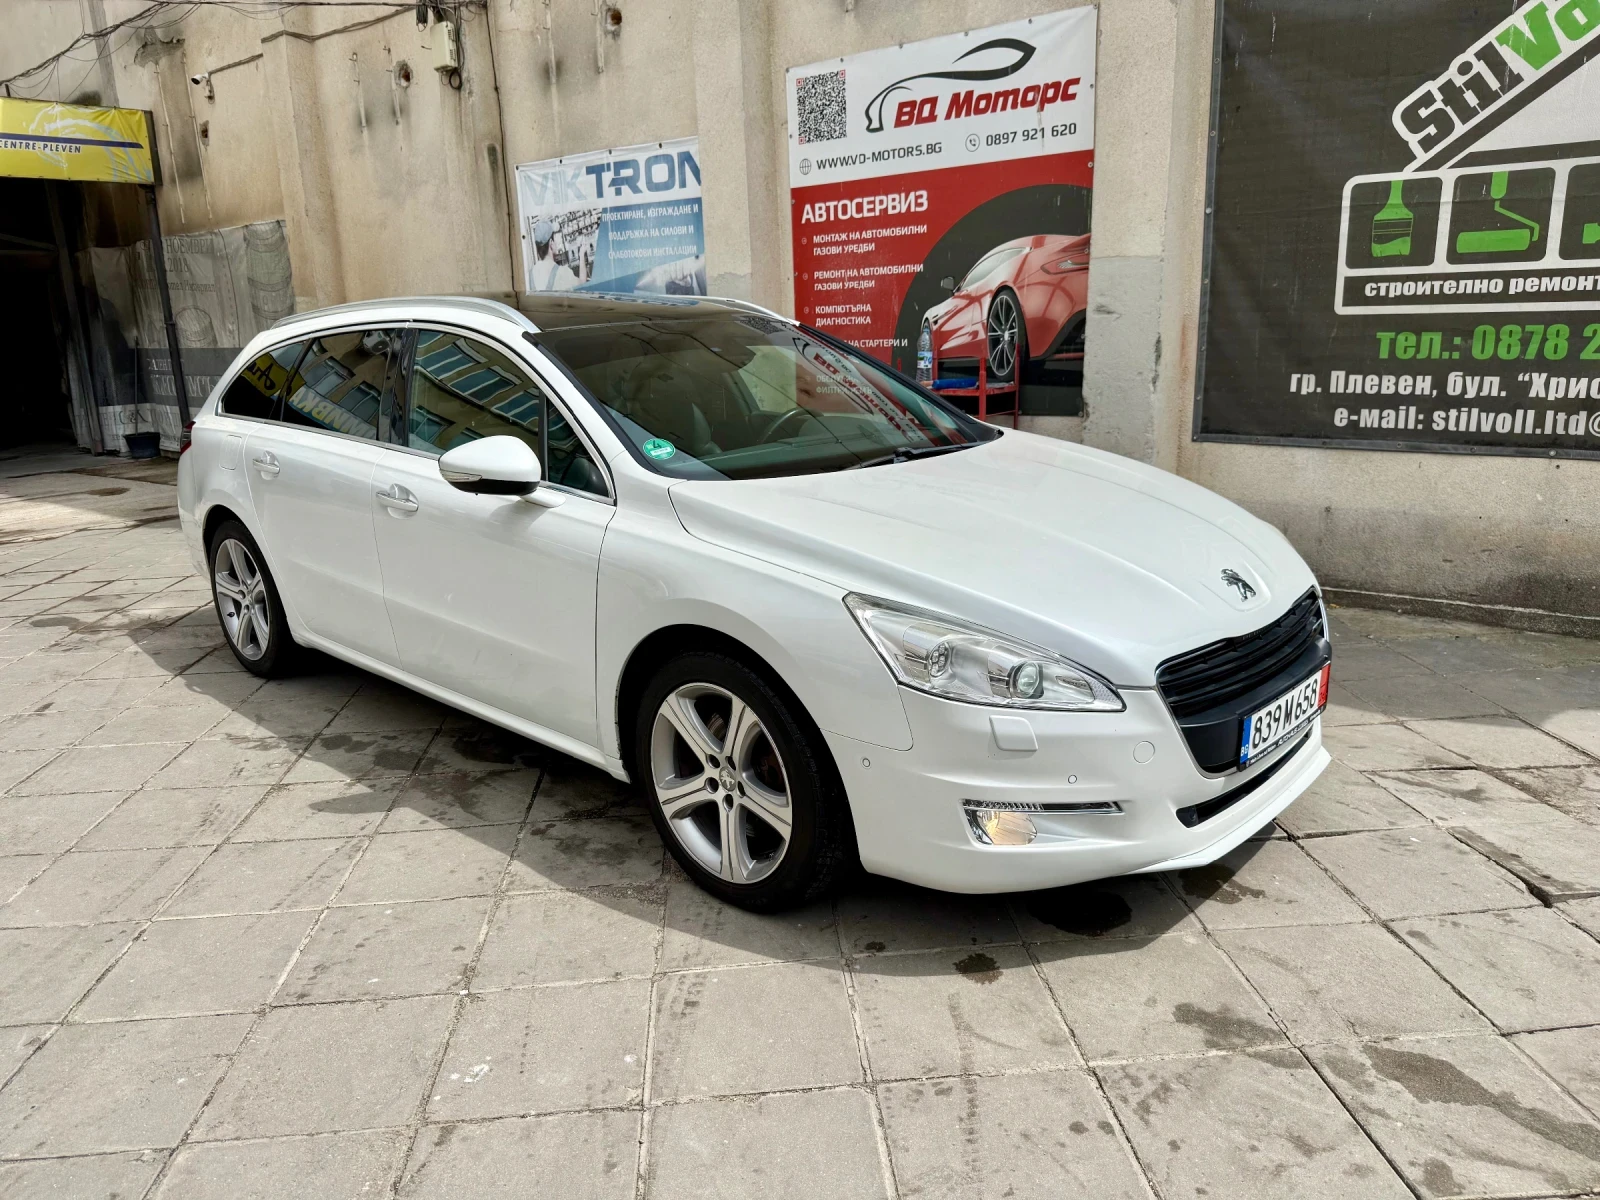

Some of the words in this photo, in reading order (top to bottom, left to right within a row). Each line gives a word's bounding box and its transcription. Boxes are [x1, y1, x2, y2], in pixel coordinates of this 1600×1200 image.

[944, 77, 1081, 121] Моторс
[985, 131, 1018, 147] 0897
[1022, 128, 1045, 142] 921
[1051, 122, 1077, 137] 620
[816, 142, 942, 170] WWW.VD-MOTORS.BG
[602, 211, 646, 222] ПРОЕКТИРАНЕ,
[647, 205, 692, 217] ИЗГРАЖДАНЕ
[693, 204, 699, 213] И
[801, 190, 928, 224] АВТОСЕРВИЗ
[609, 229, 649, 240] ПОДДРЪЖКА
[651, 228, 659, 237] НА
[660, 226, 687, 237] СИЛОВИ
[688, 225, 694, 234] И
[813, 232, 848, 243] МОНТАЖ
[849, 231, 860, 240] НА
[861, 225, 927, 238] АВТОМОБИЛНИ
[608, 247, 652, 259] СЛАБОТОКОВИ
[653, 245, 697, 258] ИНСТАЛАЦИИ
[813, 245, 842, 256] ГАЗОВИ
[843, 243, 875, 253] УРЕДБИ
[814, 269, 845, 279] РЕМОНТ
[847, 268, 858, 277] НА
[860, 264, 923, 276] АВТОМОБИЛНИ
[815, 282, 842, 291] ГАЗОВИ
[844, 280, 875, 290] УРЕДБИ
[1365, 279, 1503, 298] строително
[816, 304, 871, 314] КОМПЮТЪРНА
[816, 316, 871, 327] ДИАГНОСТИКА
[860, 339, 900, 348] СТАРТЕРИ
[901, 338, 908, 346] И
[1376, 331, 1460, 359] тел.:
[1471, 324, 1570, 360] 0878
[1580, 323, 1600, 360] 2
[1289, 373, 1322, 395] гр.
[1329, 370, 1438, 398] Плевен,
[1446, 371, 1507, 399] бул.
